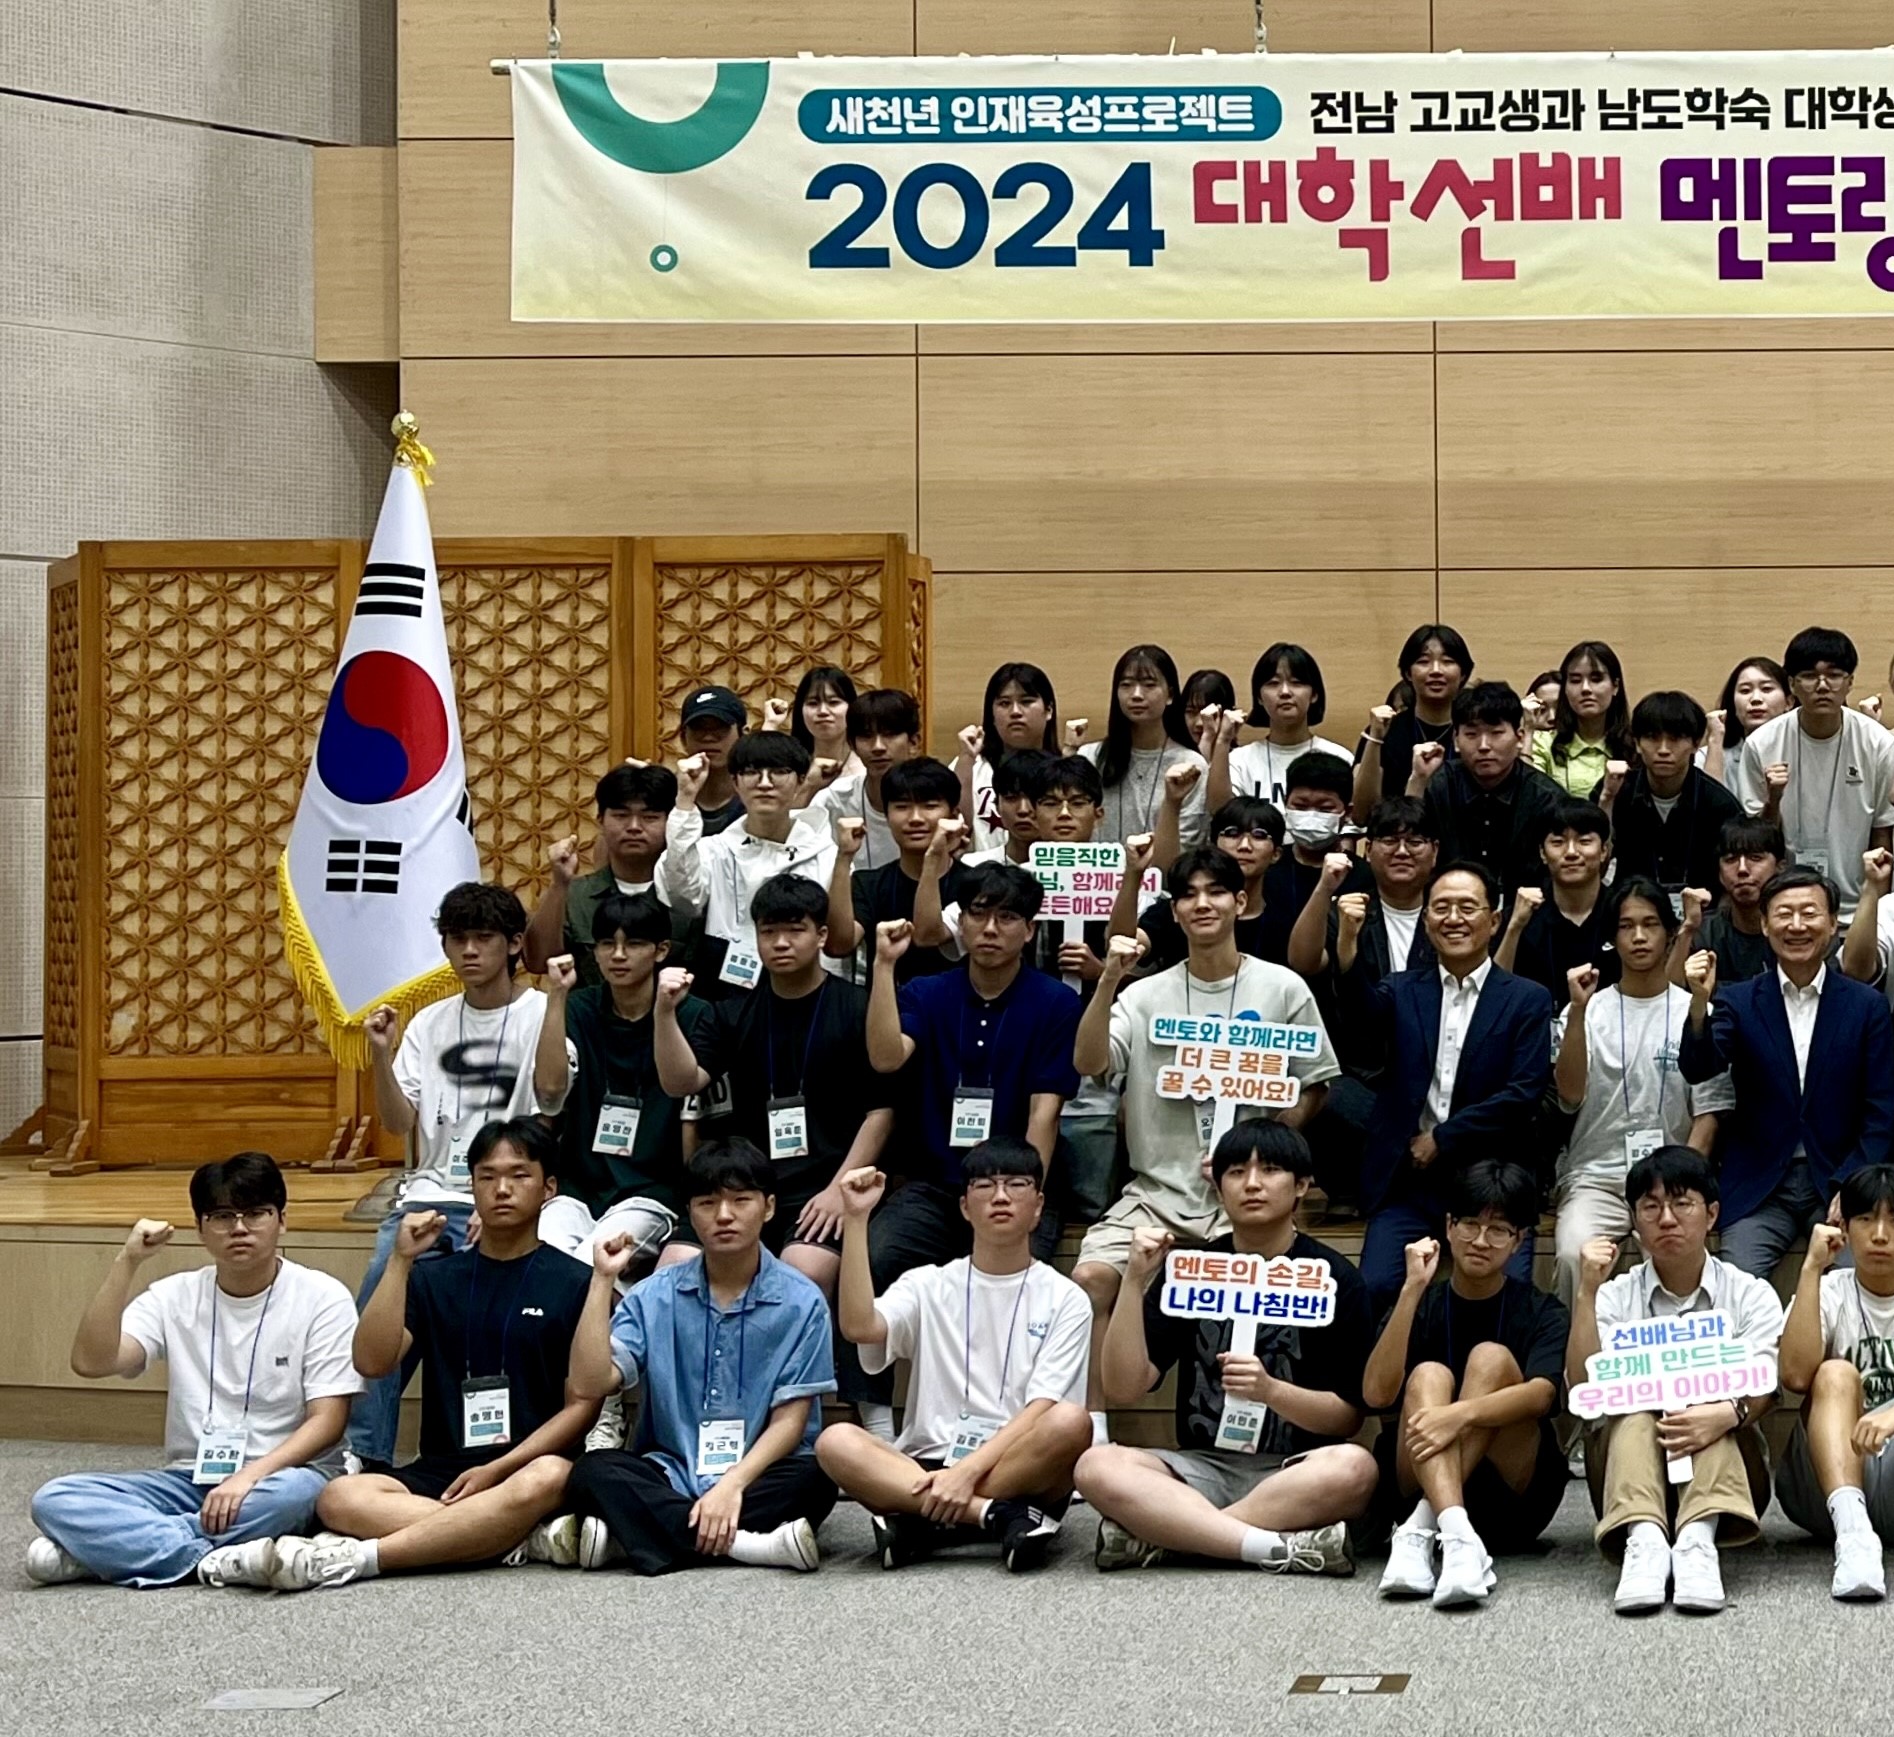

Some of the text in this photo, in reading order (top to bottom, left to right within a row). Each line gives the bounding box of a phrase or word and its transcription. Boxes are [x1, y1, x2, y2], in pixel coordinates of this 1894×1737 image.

[825, 94, 1255, 135] 새천년 인재육성프로젝트
[1309, 89, 1397, 134] 전남
[1409, 88, 1586, 134] 고교생과
[1598, 87, 1771, 132] 남도학숙
[805, 162, 1165, 270] 2024
[1035, 848, 1120, 867] 믿음직한
[1155, 1018, 1317, 1052] 멘토와 함께라면
[1181, 1048, 1282, 1075] 더 큰 꿈을
[1162, 1071, 1294, 1101] 꿀 수 있어요!
[1174, 1256, 1329, 1291] 멘토의 손길,
[1168, 1287, 1328, 1319] 나의 나침반!
[1611, 1315, 1725, 1350] 선배님과
[1594, 1343, 1746, 1381] 함께 만드는
[1578, 1366, 1768, 1410] 우리의 이야기!
